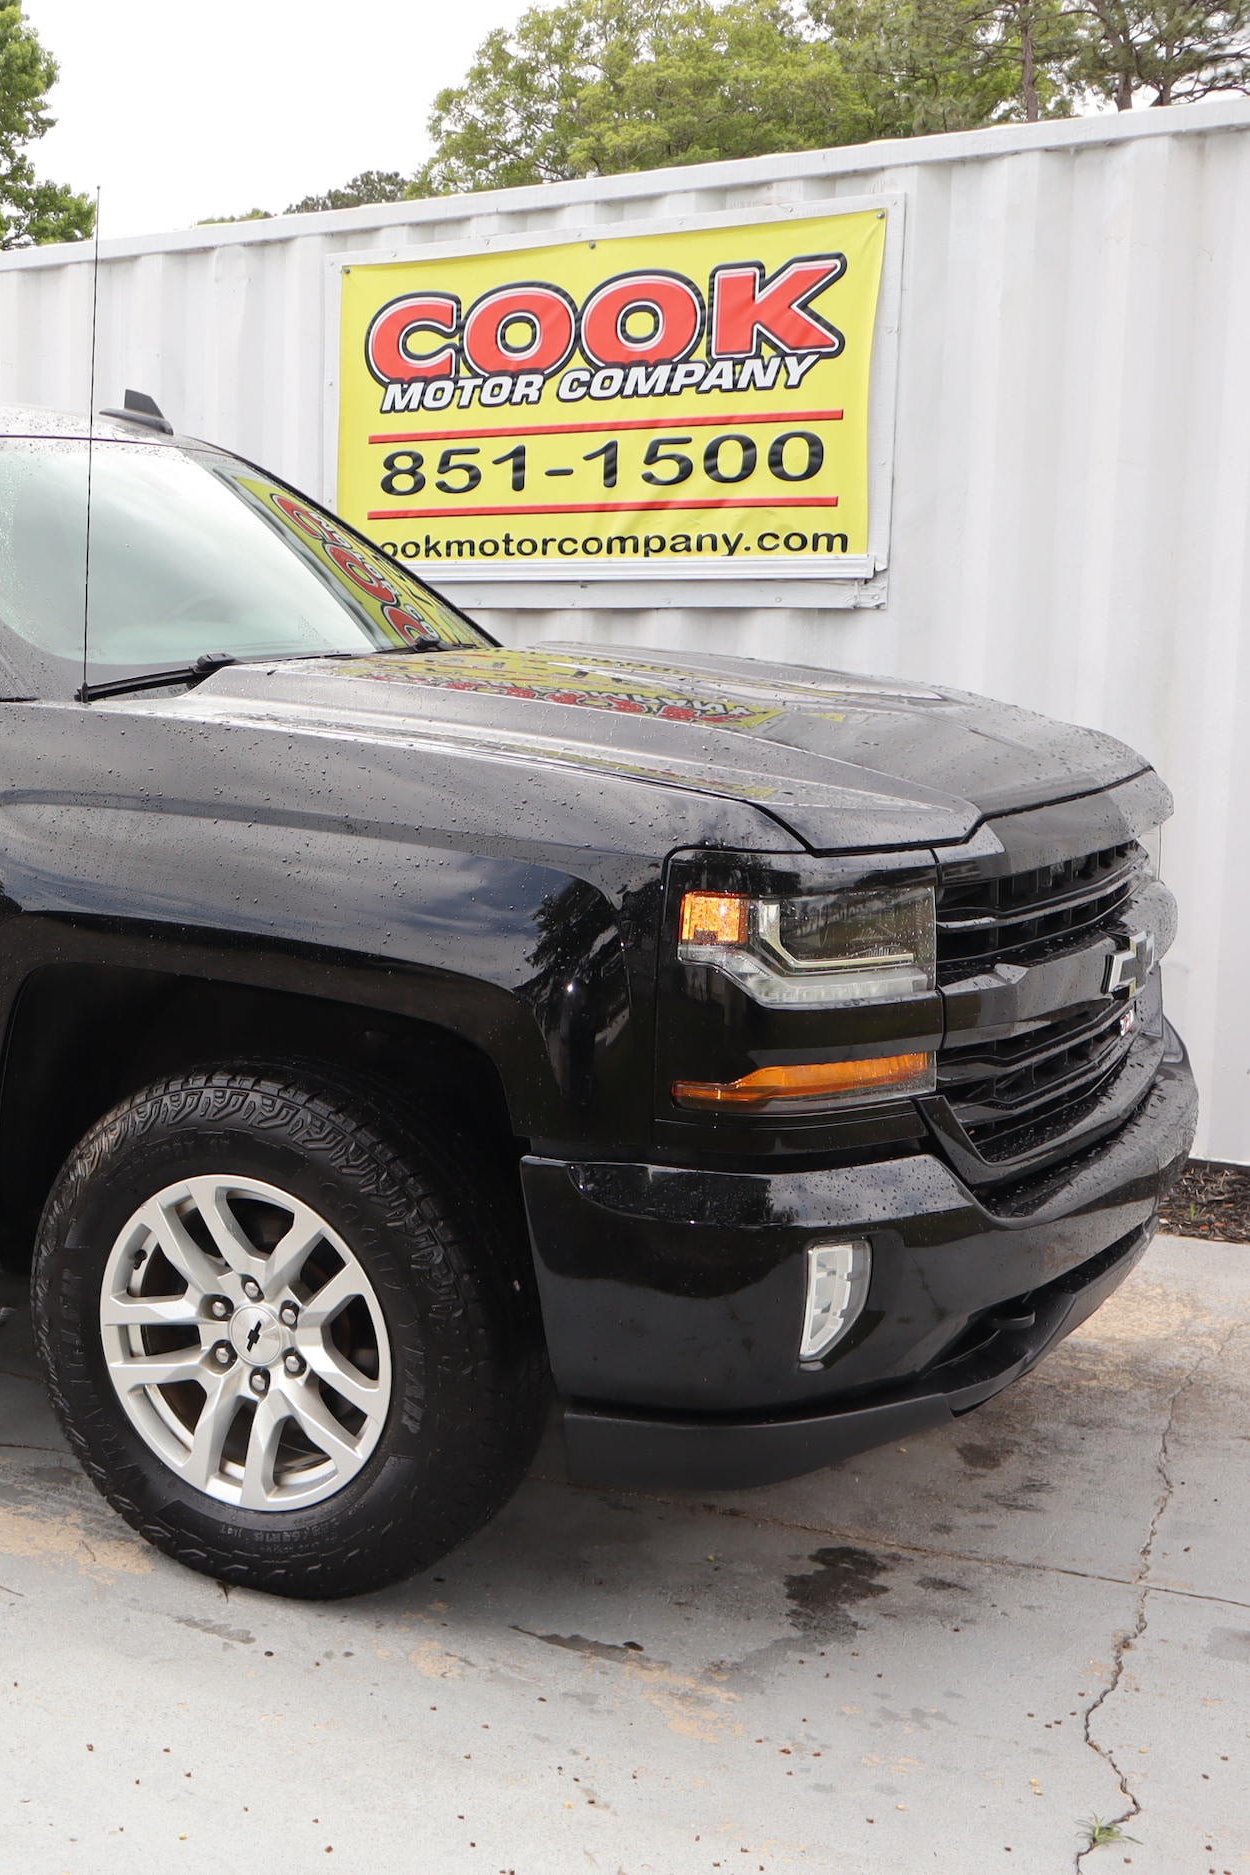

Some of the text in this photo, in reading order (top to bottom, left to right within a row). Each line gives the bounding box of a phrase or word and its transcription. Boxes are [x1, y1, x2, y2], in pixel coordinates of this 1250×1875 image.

[365, 252, 847, 385] COOK
[380, 352, 824, 414] MOTOR COMPANY
[380, 431, 825, 496] 851-1500
[379, 532, 849, 560] ookmotorcompany.com
